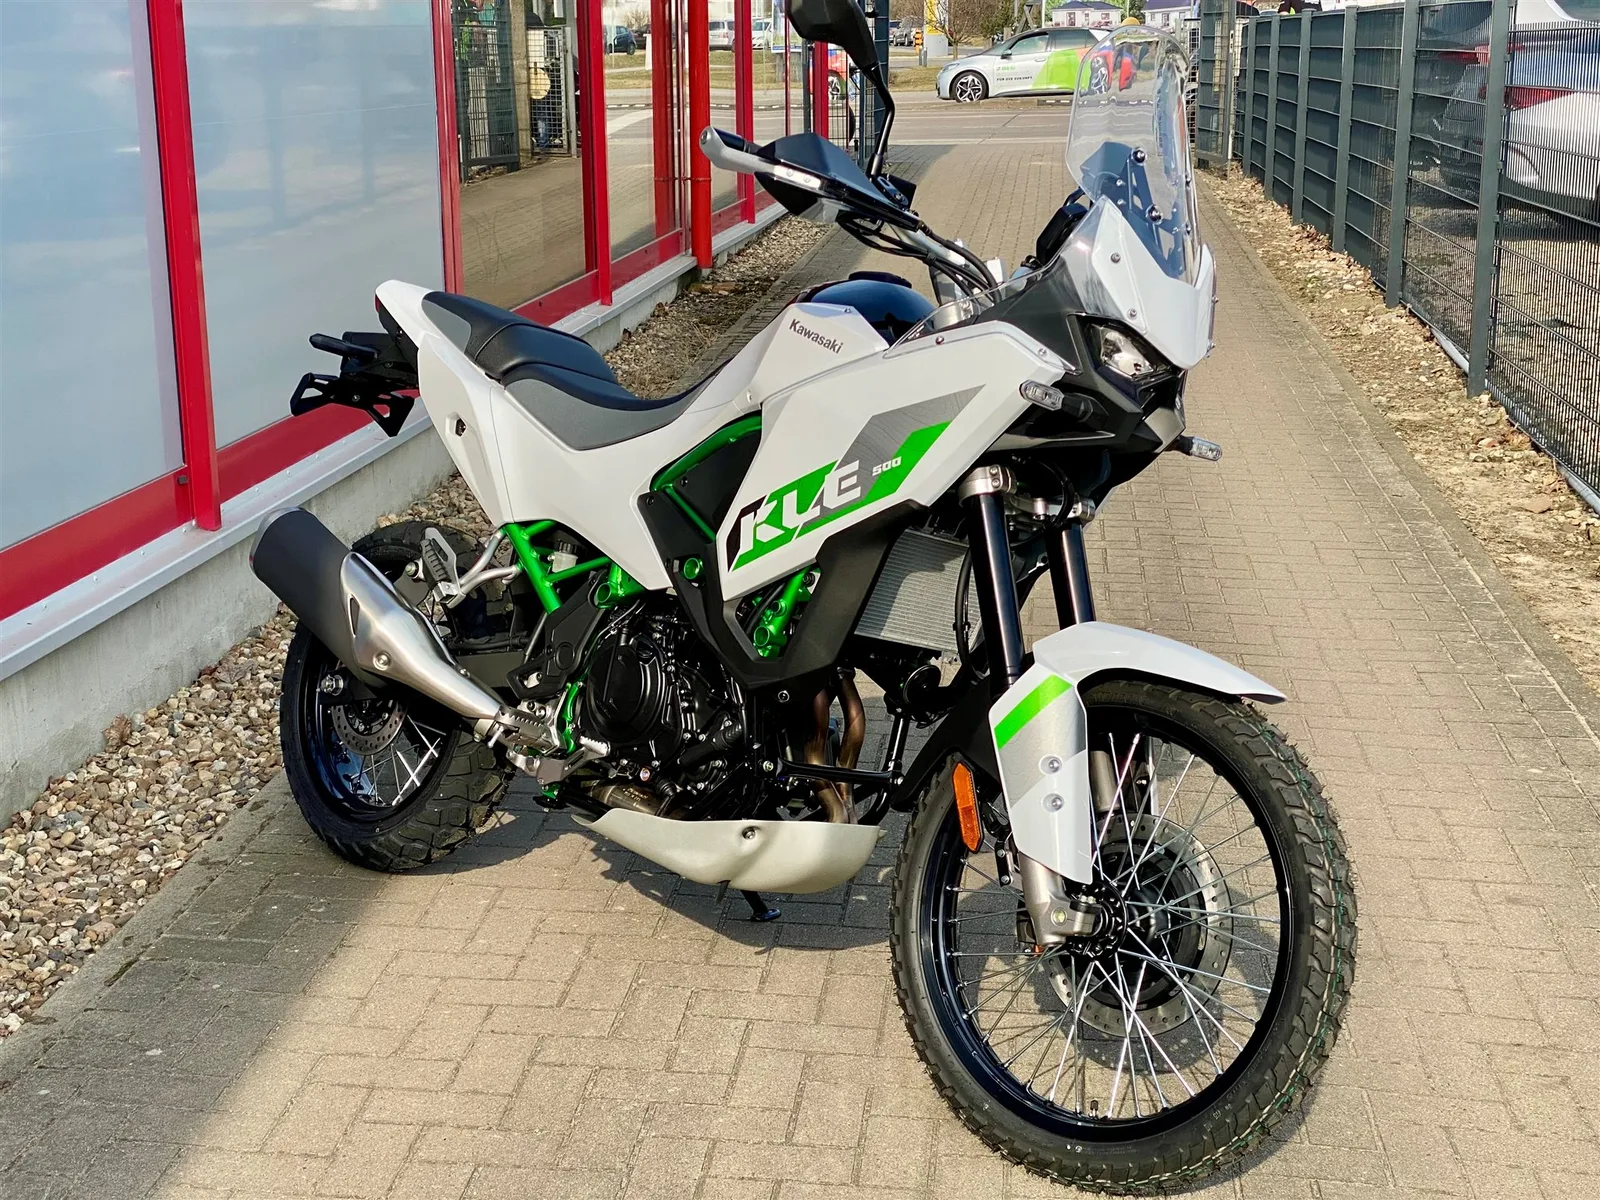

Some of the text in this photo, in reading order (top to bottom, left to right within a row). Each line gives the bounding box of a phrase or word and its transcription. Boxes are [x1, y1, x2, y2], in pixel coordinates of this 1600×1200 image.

[788, 318, 844, 354] Kawasaki
[739, 456, 902, 556] KLE 500
